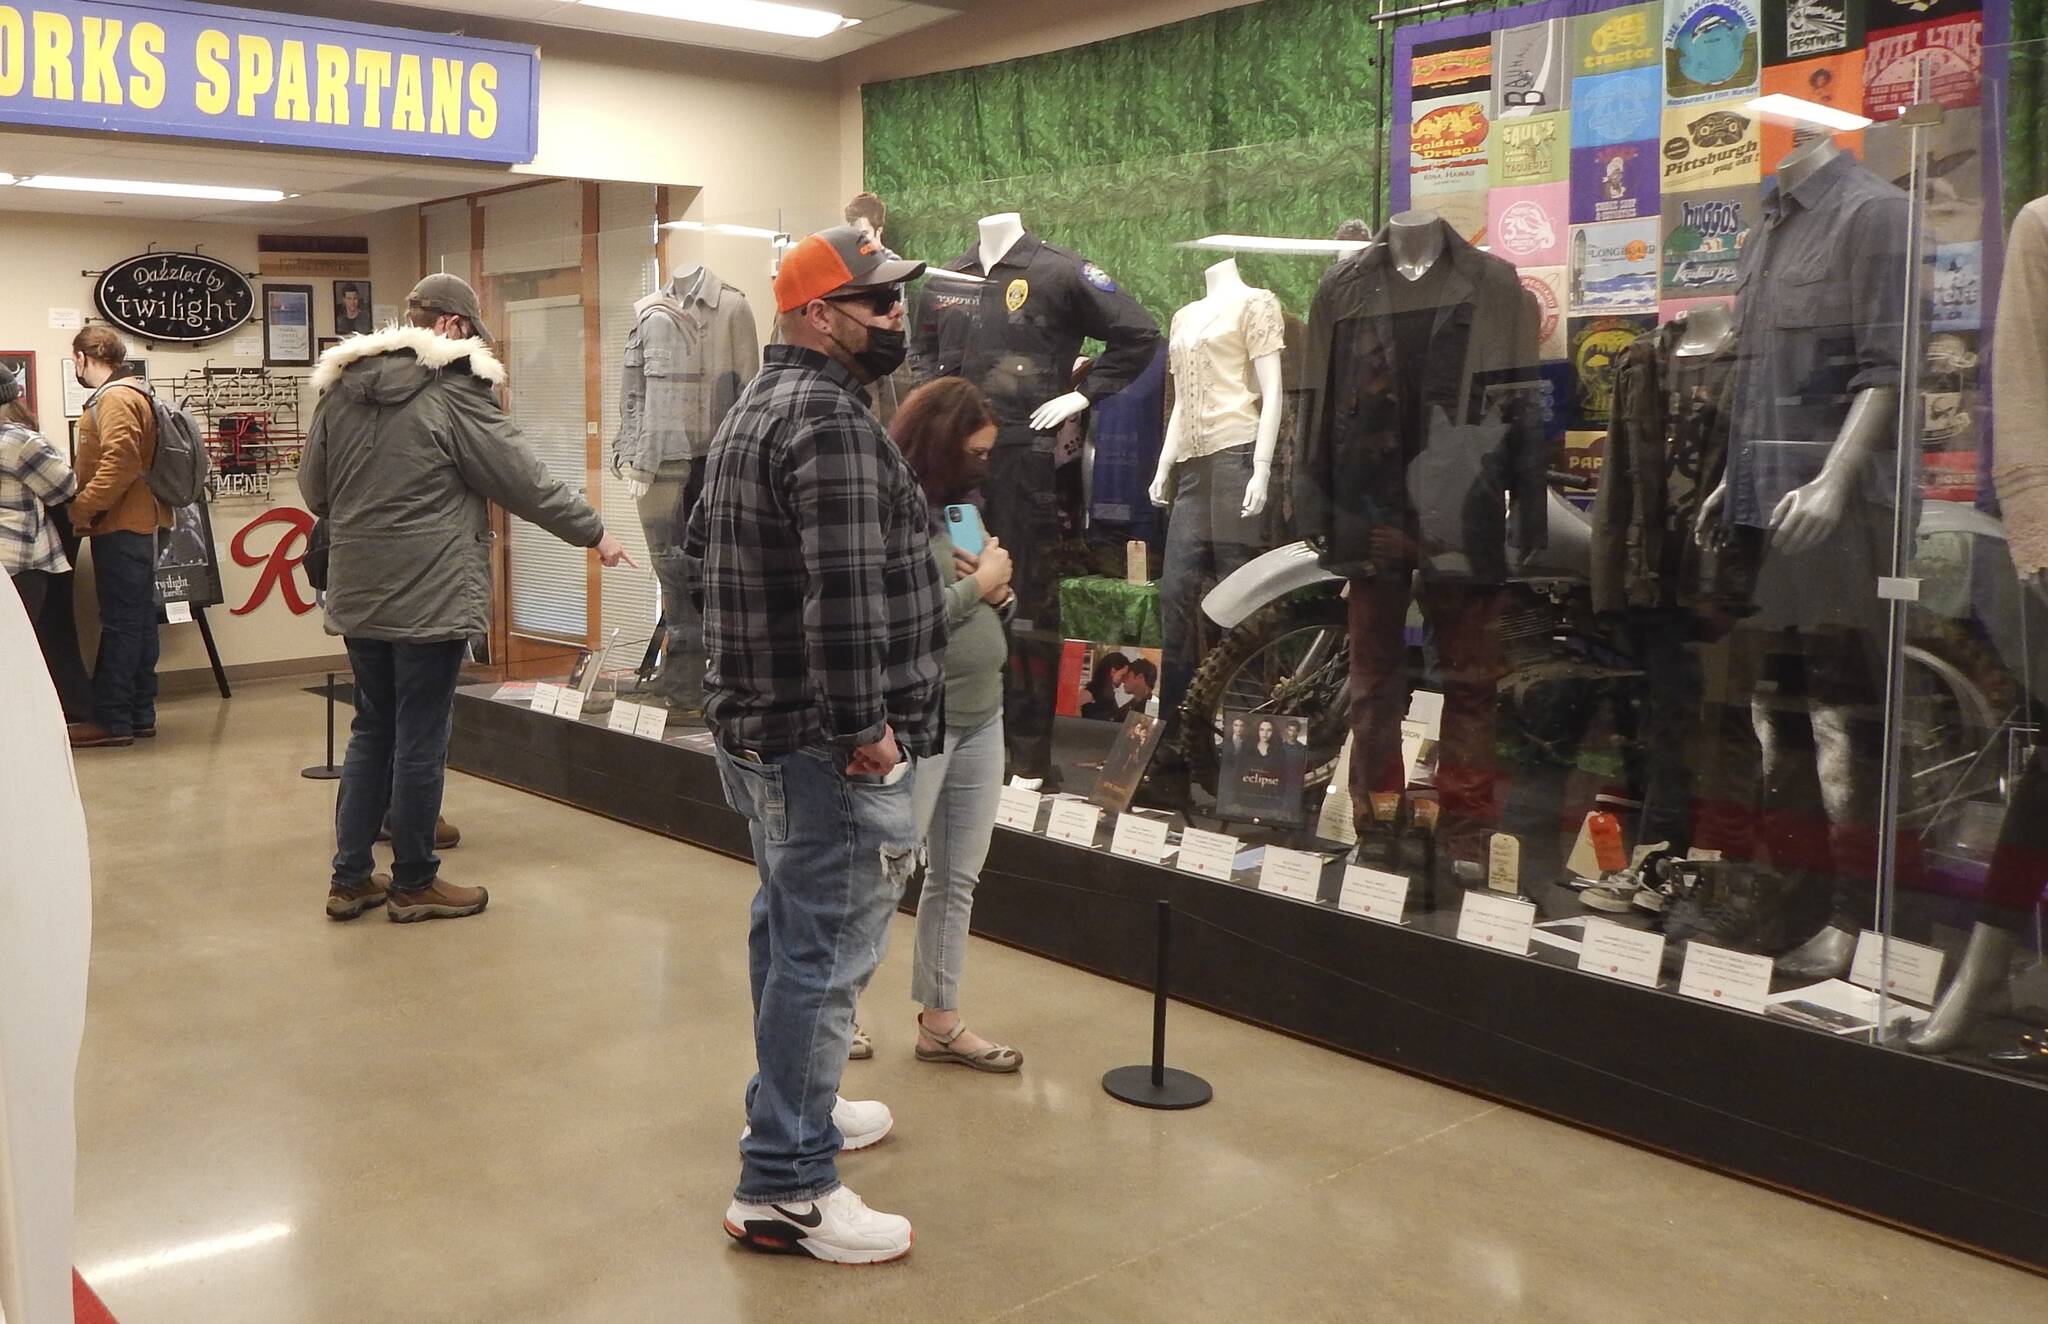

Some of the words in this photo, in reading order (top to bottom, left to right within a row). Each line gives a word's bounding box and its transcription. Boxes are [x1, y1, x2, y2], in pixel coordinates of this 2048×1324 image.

[1789, 32, 1843, 51] FESTIVAL
[195, 29, 499, 140] SPARTANS
[1410, 138, 1465, 152] Golden
[1423, 145, 1484, 160] Dragon
[1663, 139, 1758, 178] Pittsburgh
[133, 258, 204, 286] Dazzled
[206, 268, 225, 293] by
[115, 290, 239, 328] twilight
[1569, 455, 1603, 469] PAP
[214, 473, 270, 497] MENU
[230, 507, 317, 616] R
[1242, 772, 1280, 789] eclipse
